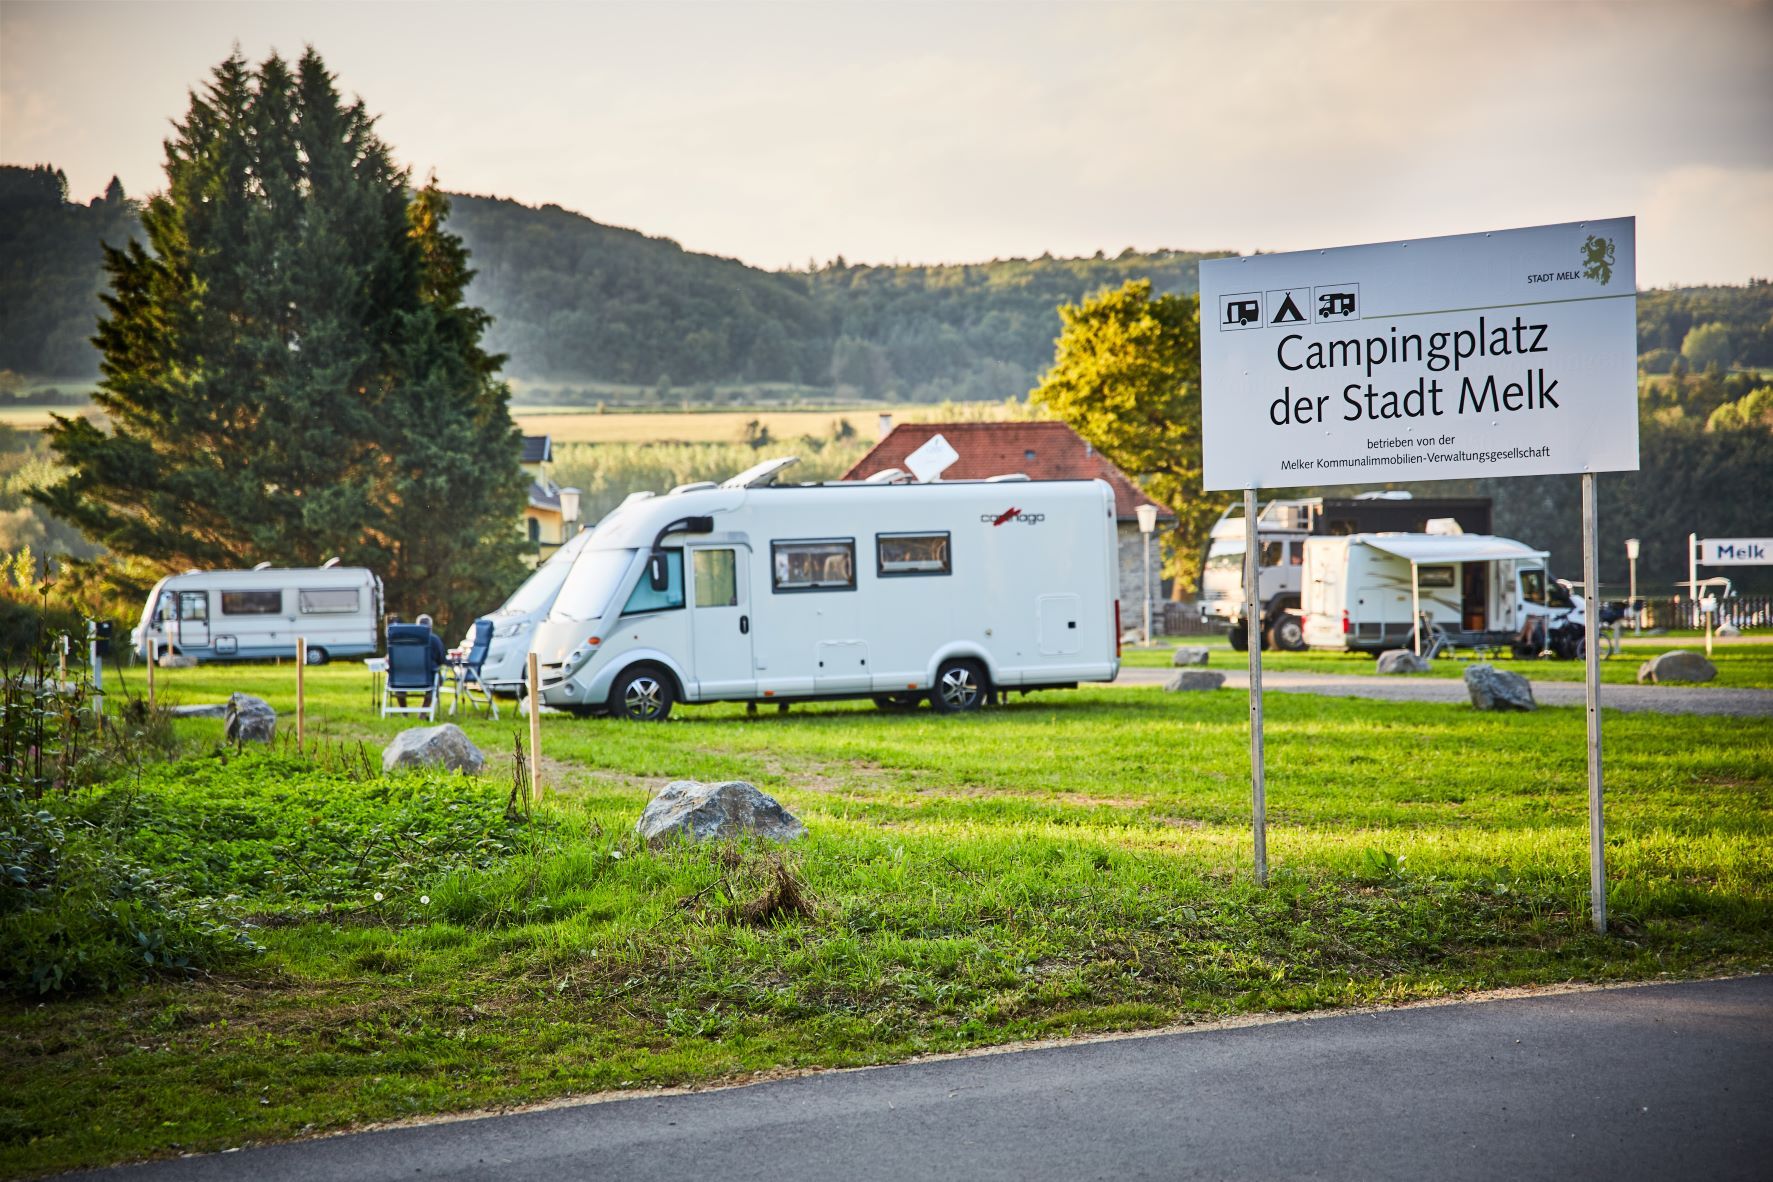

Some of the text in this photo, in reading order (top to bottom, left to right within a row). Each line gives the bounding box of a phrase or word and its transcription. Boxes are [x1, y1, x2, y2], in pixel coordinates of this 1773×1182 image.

[1527, 271, 1581, 284] STADT MELK
[1277, 316, 1549, 378] Campingplatz
[1269, 368, 1560, 426] der Stadt Melk
[1367, 435, 1456, 449] betrieben von der
[1281, 445, 1551, 470] Melker Kommunalimmobilien-Verwaltungsgesellschaft
[1717, 543, 1764, 559] Melk
